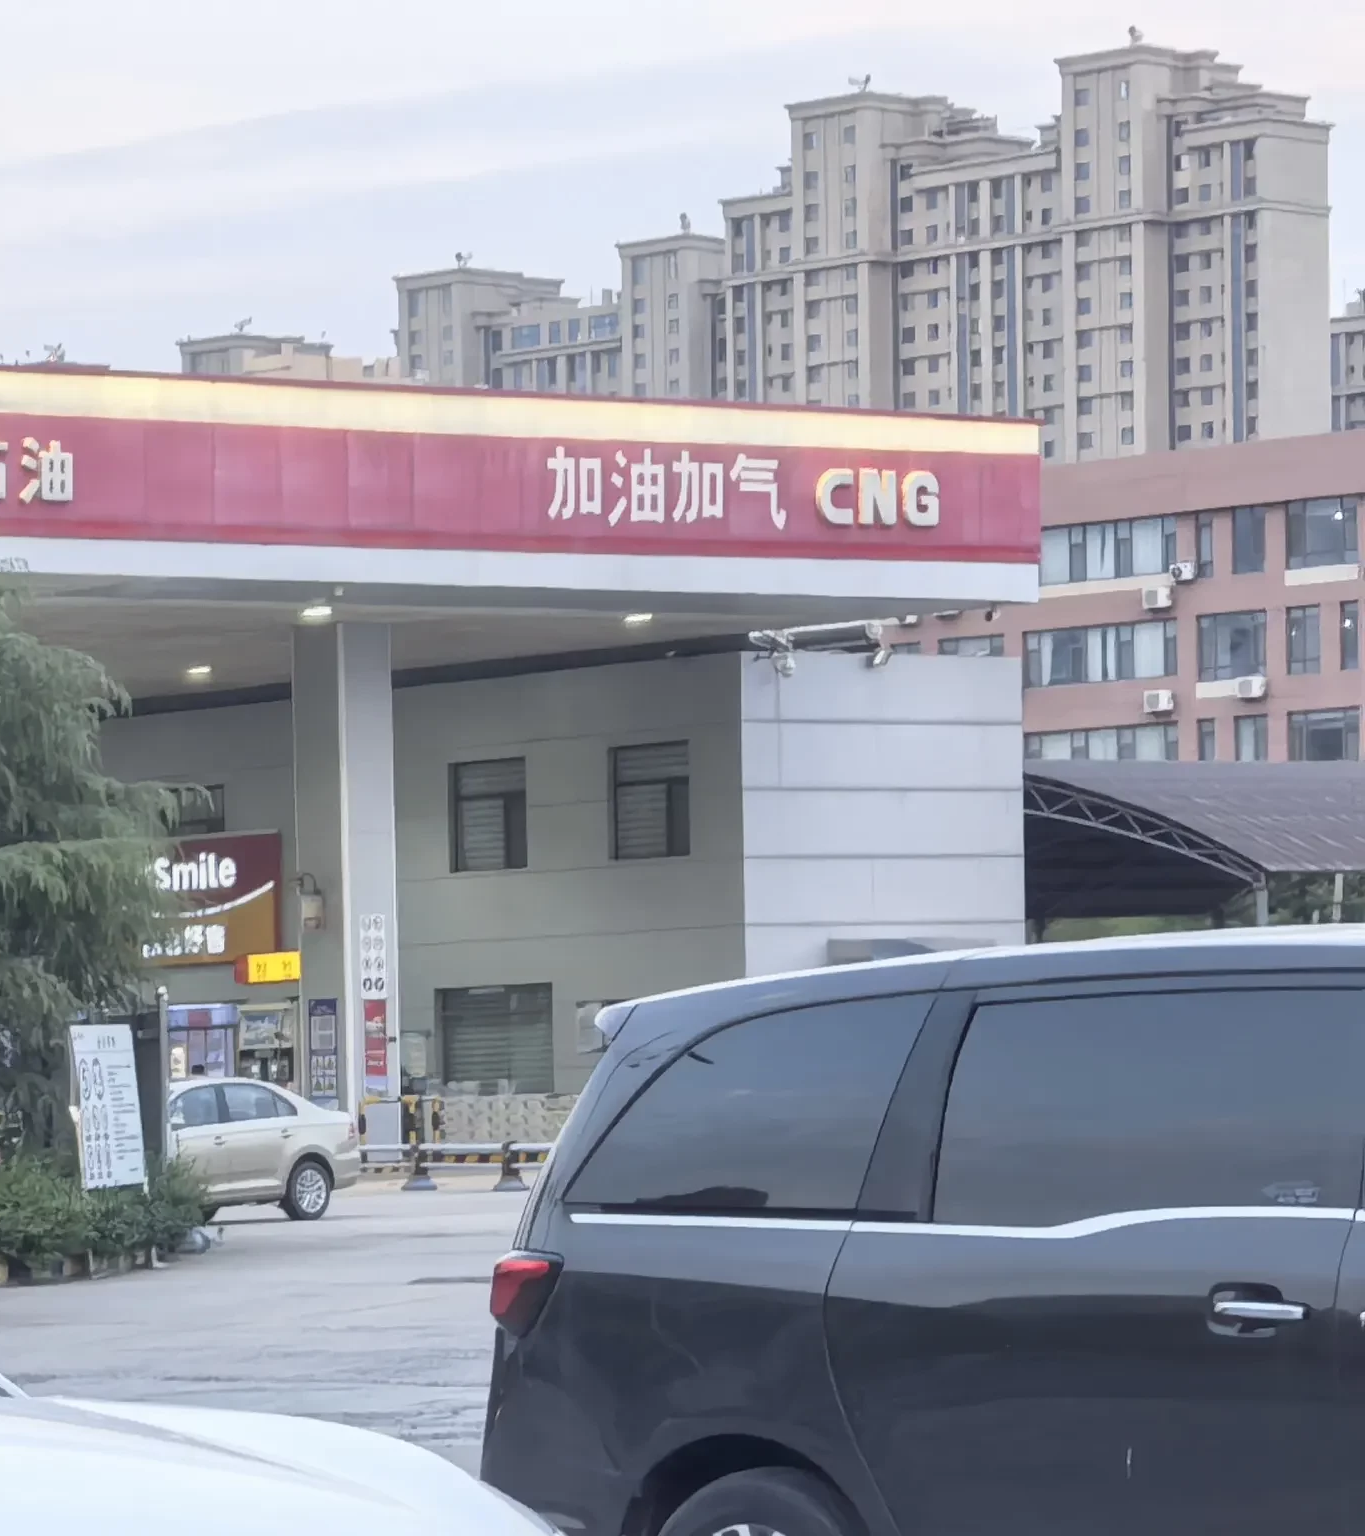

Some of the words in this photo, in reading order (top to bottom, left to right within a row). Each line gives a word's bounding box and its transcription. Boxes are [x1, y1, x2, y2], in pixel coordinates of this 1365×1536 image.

[546, 446, 788, 530] 加油加气
[815, 467, 940, 529] CNG
